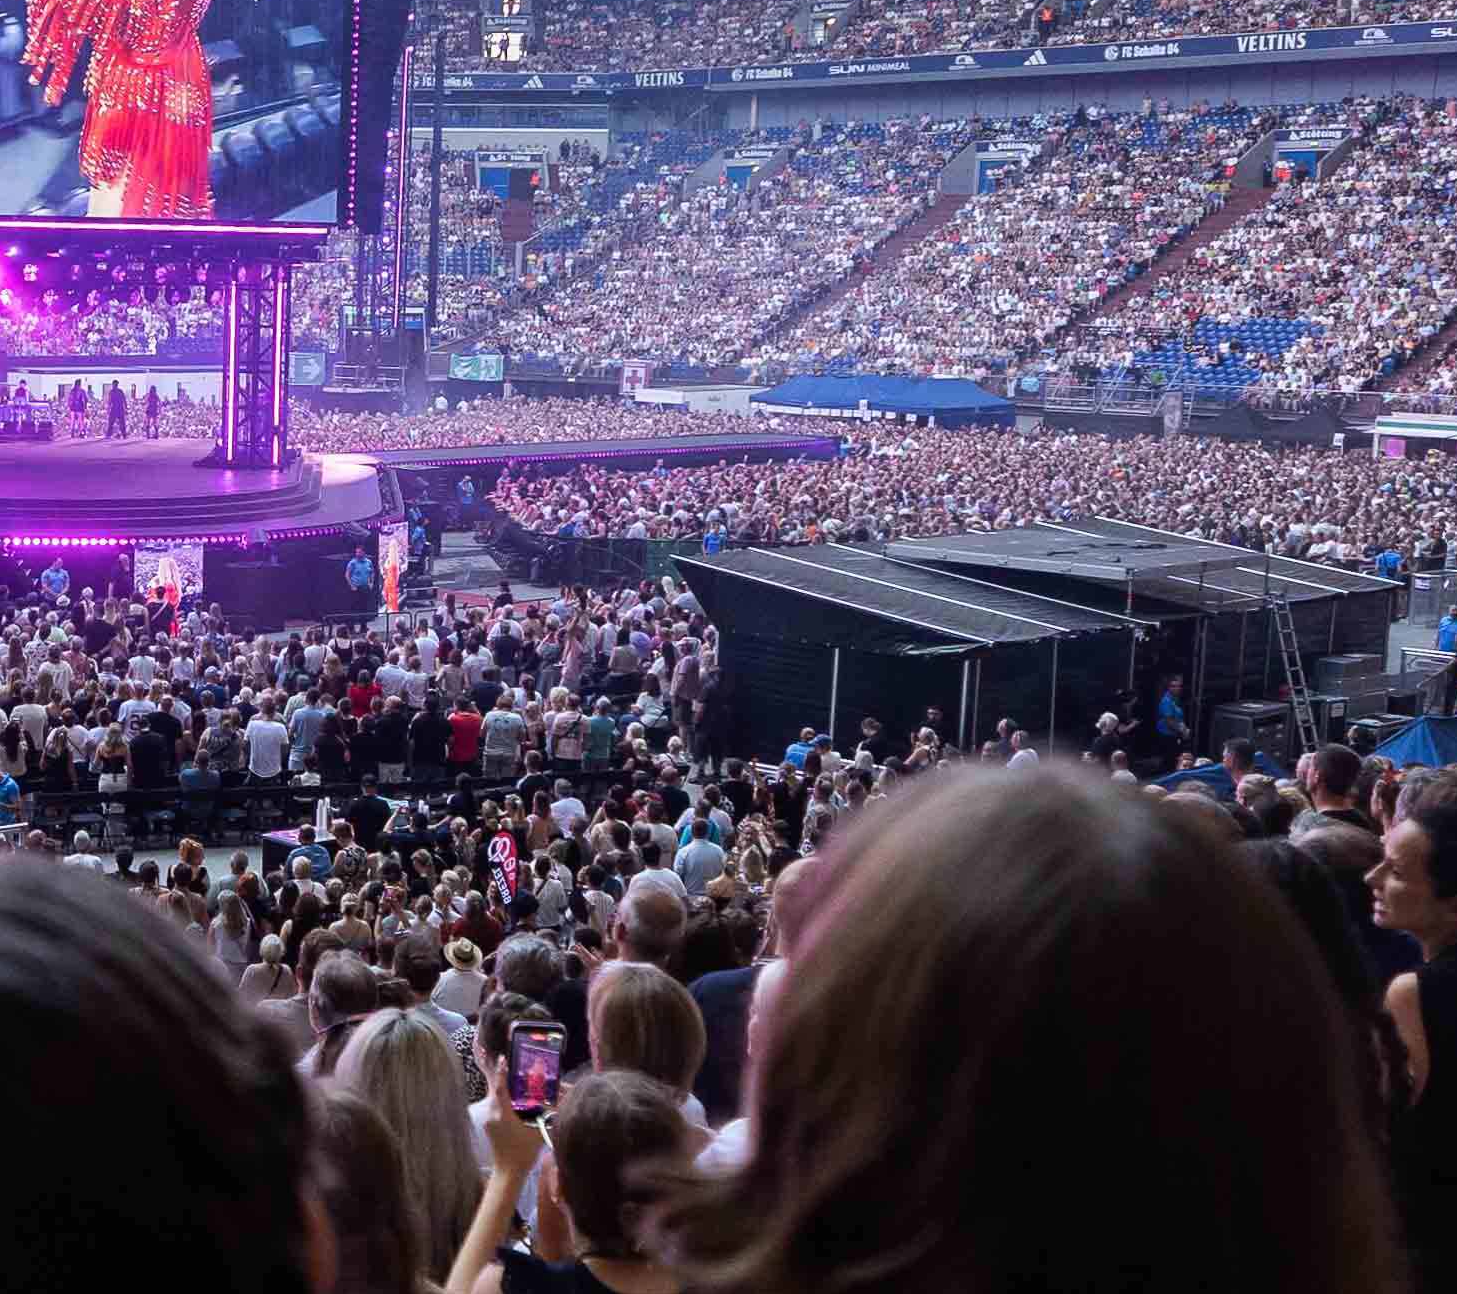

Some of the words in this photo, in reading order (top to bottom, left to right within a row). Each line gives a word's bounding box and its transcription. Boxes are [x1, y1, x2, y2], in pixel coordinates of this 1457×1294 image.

[1237, 32, 1307, 53] VELTINS
[828, 64, 865, 75] SUN
[634, 71, 685, 88] VELTINS
